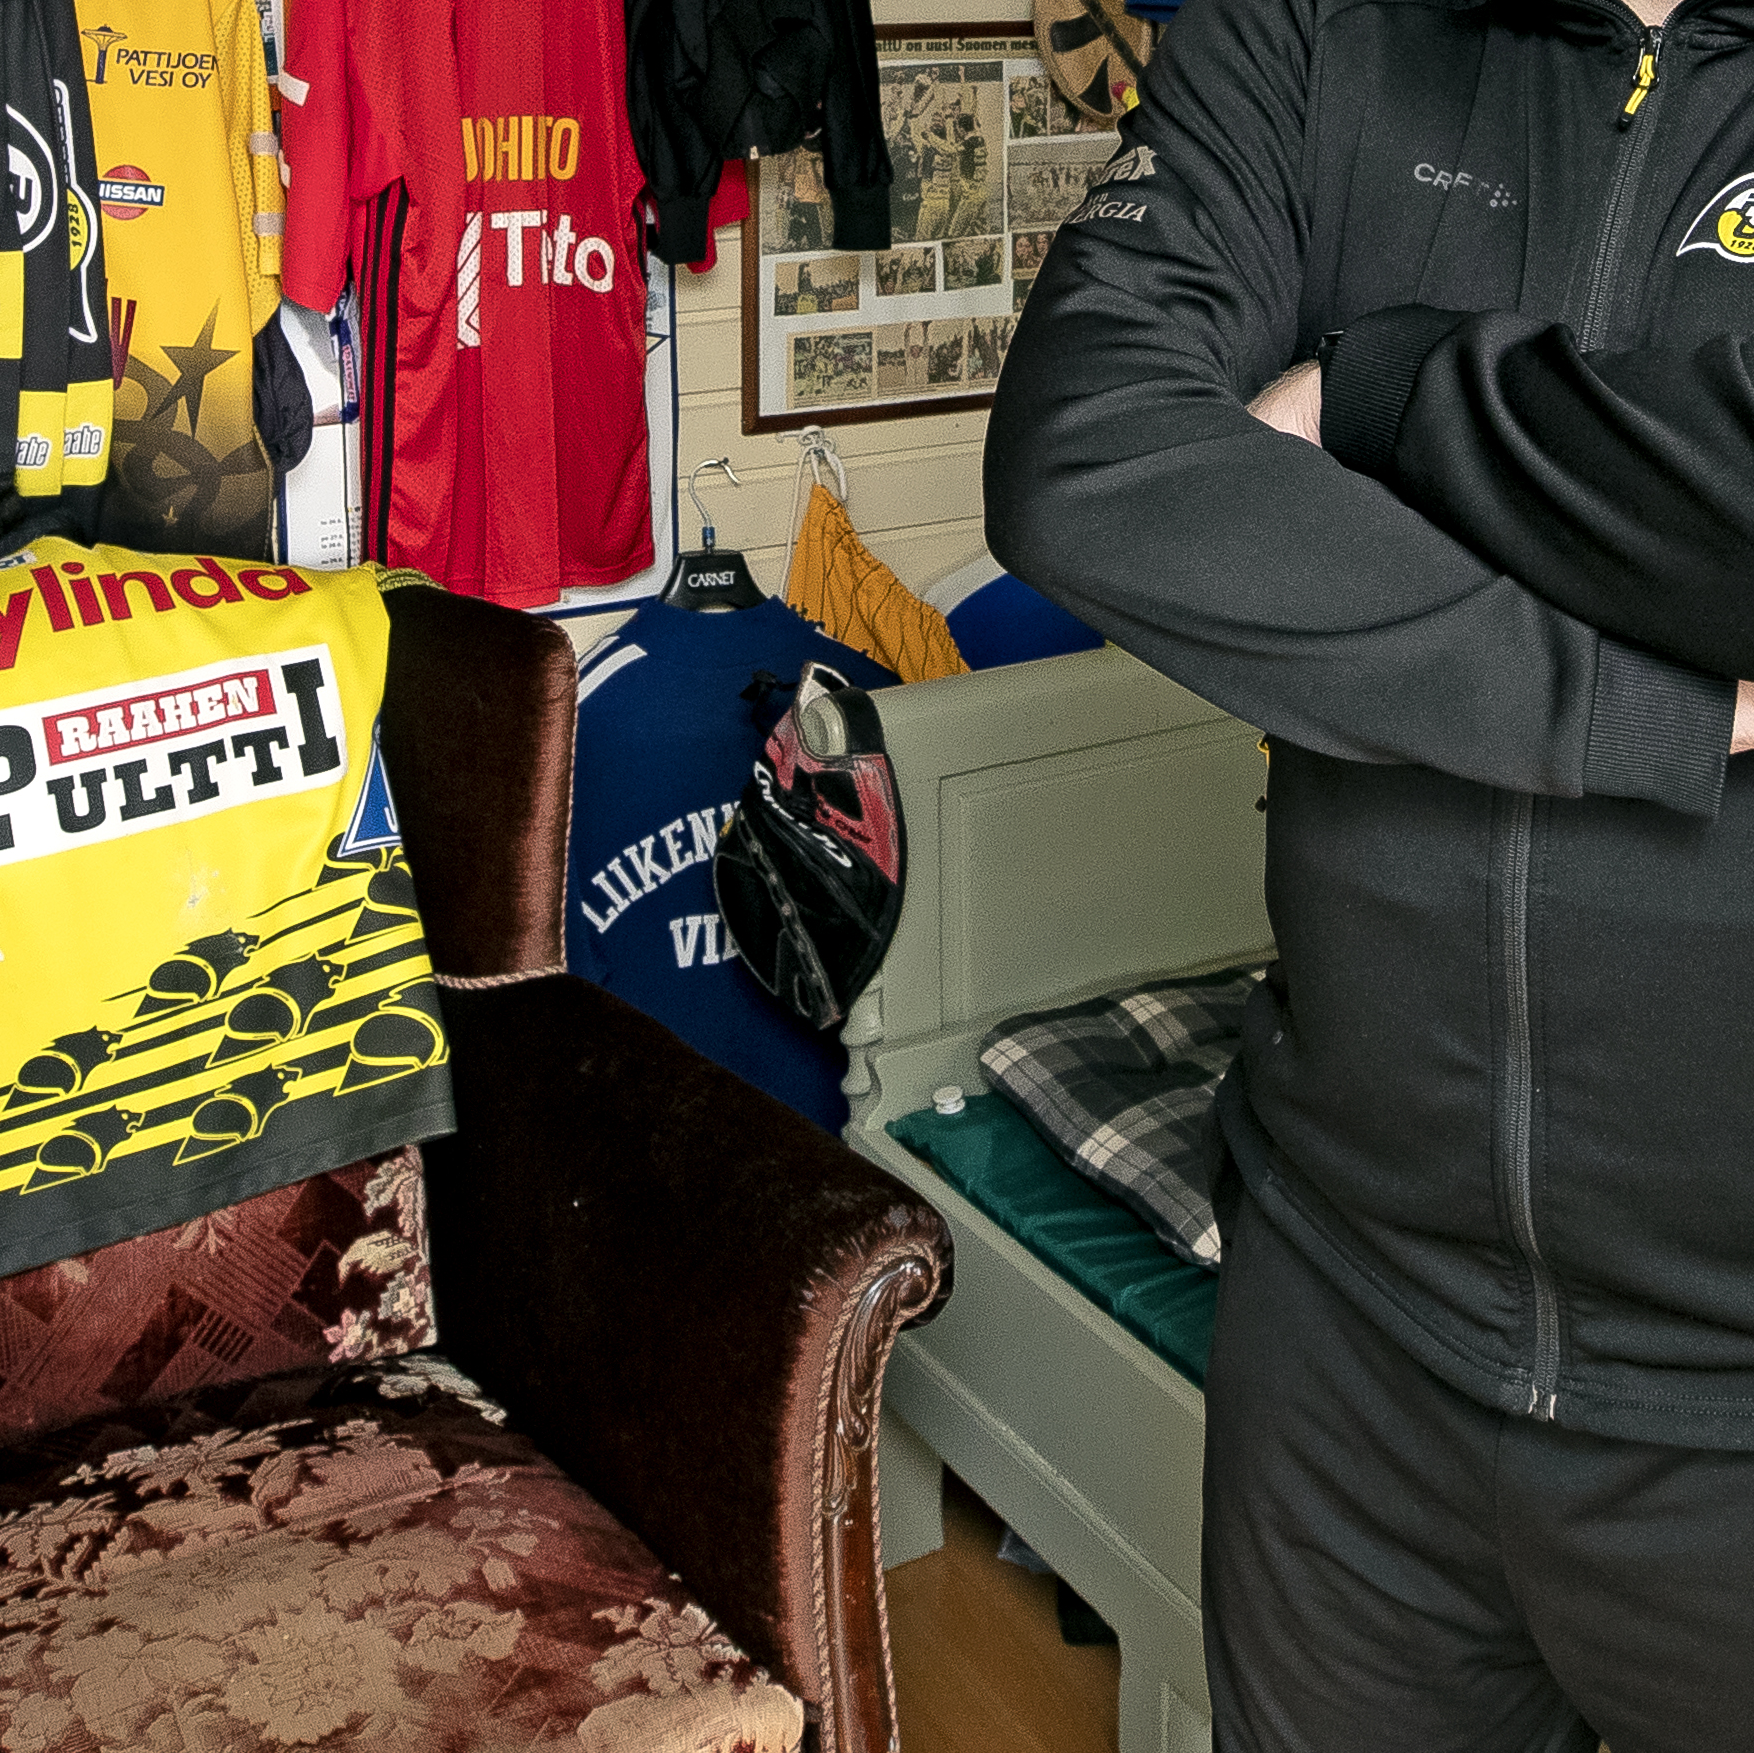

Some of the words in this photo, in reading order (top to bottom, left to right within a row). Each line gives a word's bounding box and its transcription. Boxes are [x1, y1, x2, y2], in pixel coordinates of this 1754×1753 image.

[906, 42, 923, 52] on
[925, 39, 953, 52] uusi
[956, 38, 1008, 52] Suomen
[129, 68, 173, 87] VESI
[182, 71, 211, 88] OY
[688, 571, 735, 588] CARNET
[55, 671, 265, 757] RAAHEN
